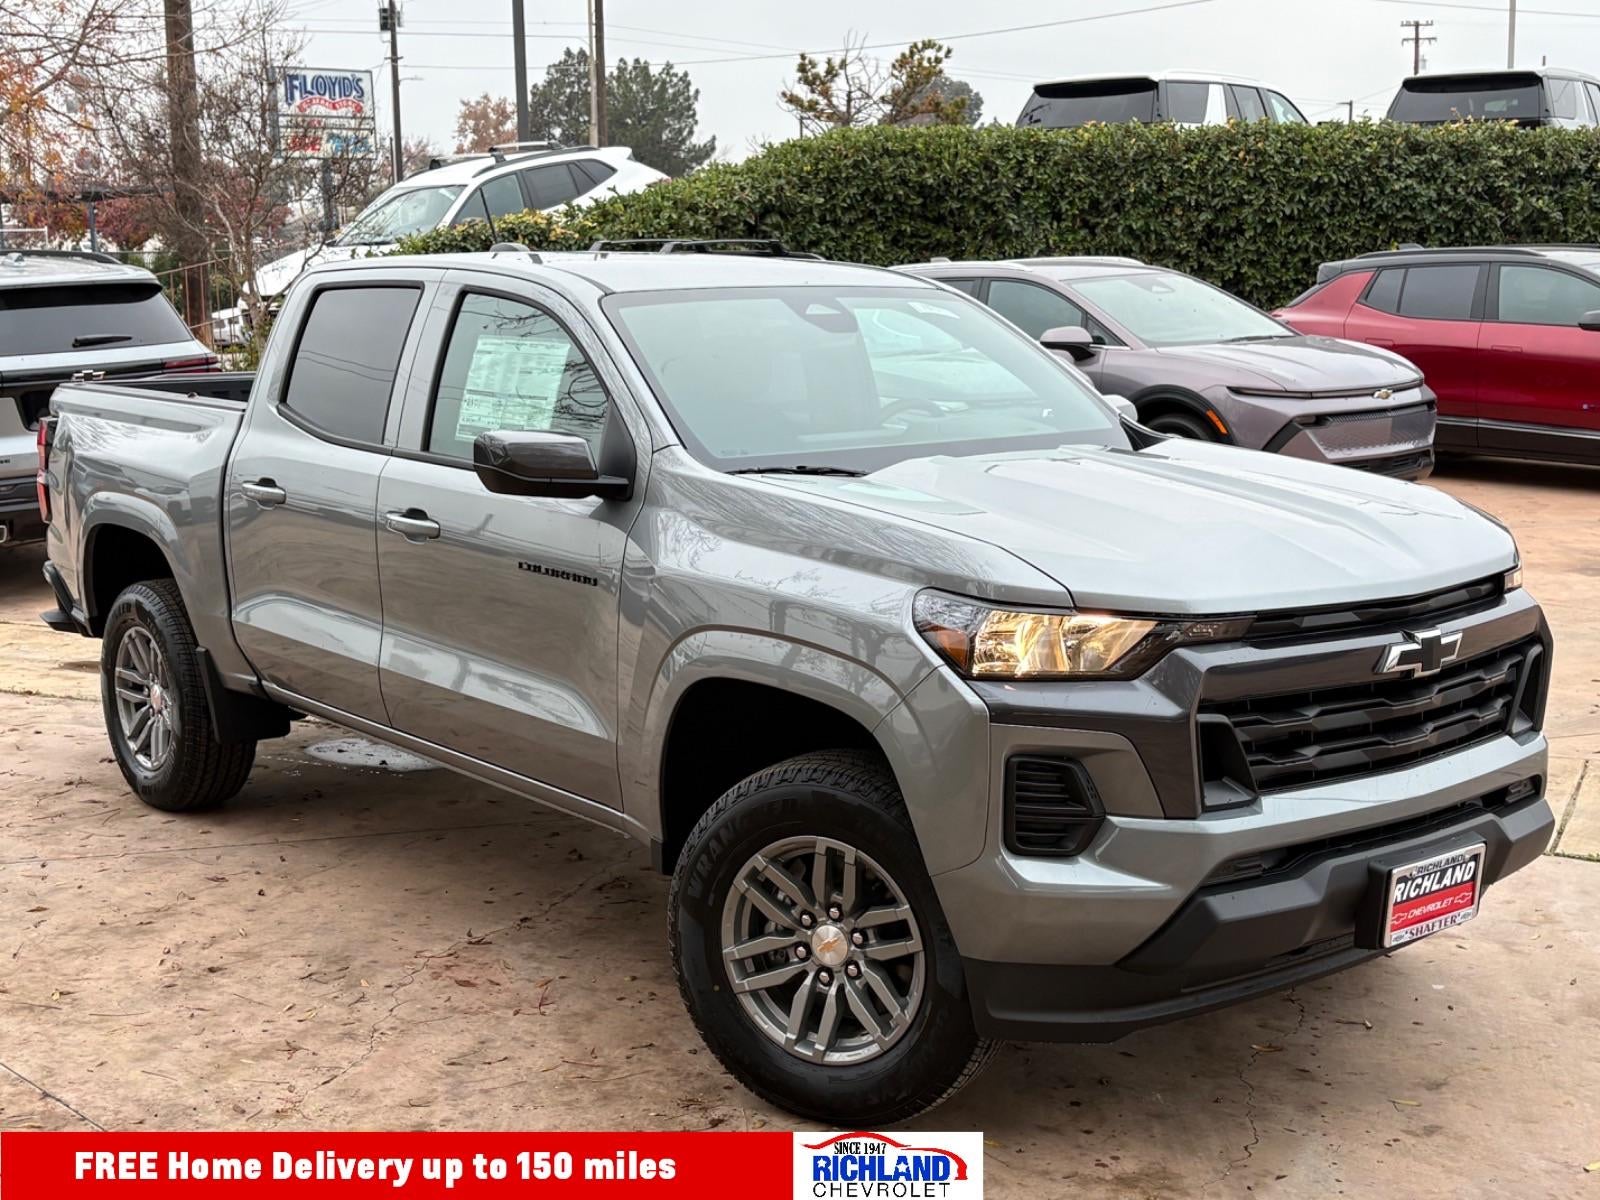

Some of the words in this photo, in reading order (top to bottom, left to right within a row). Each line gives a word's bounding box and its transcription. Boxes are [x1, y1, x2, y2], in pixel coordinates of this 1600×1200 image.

[286, 73, 364, 105] FLOYD'S
[1417, 854, 1465, 875] RICHLAND
[1393, 861, 1476, 904] RICHLAND
[1408, 897, 1454, 919] CHEVROLET
